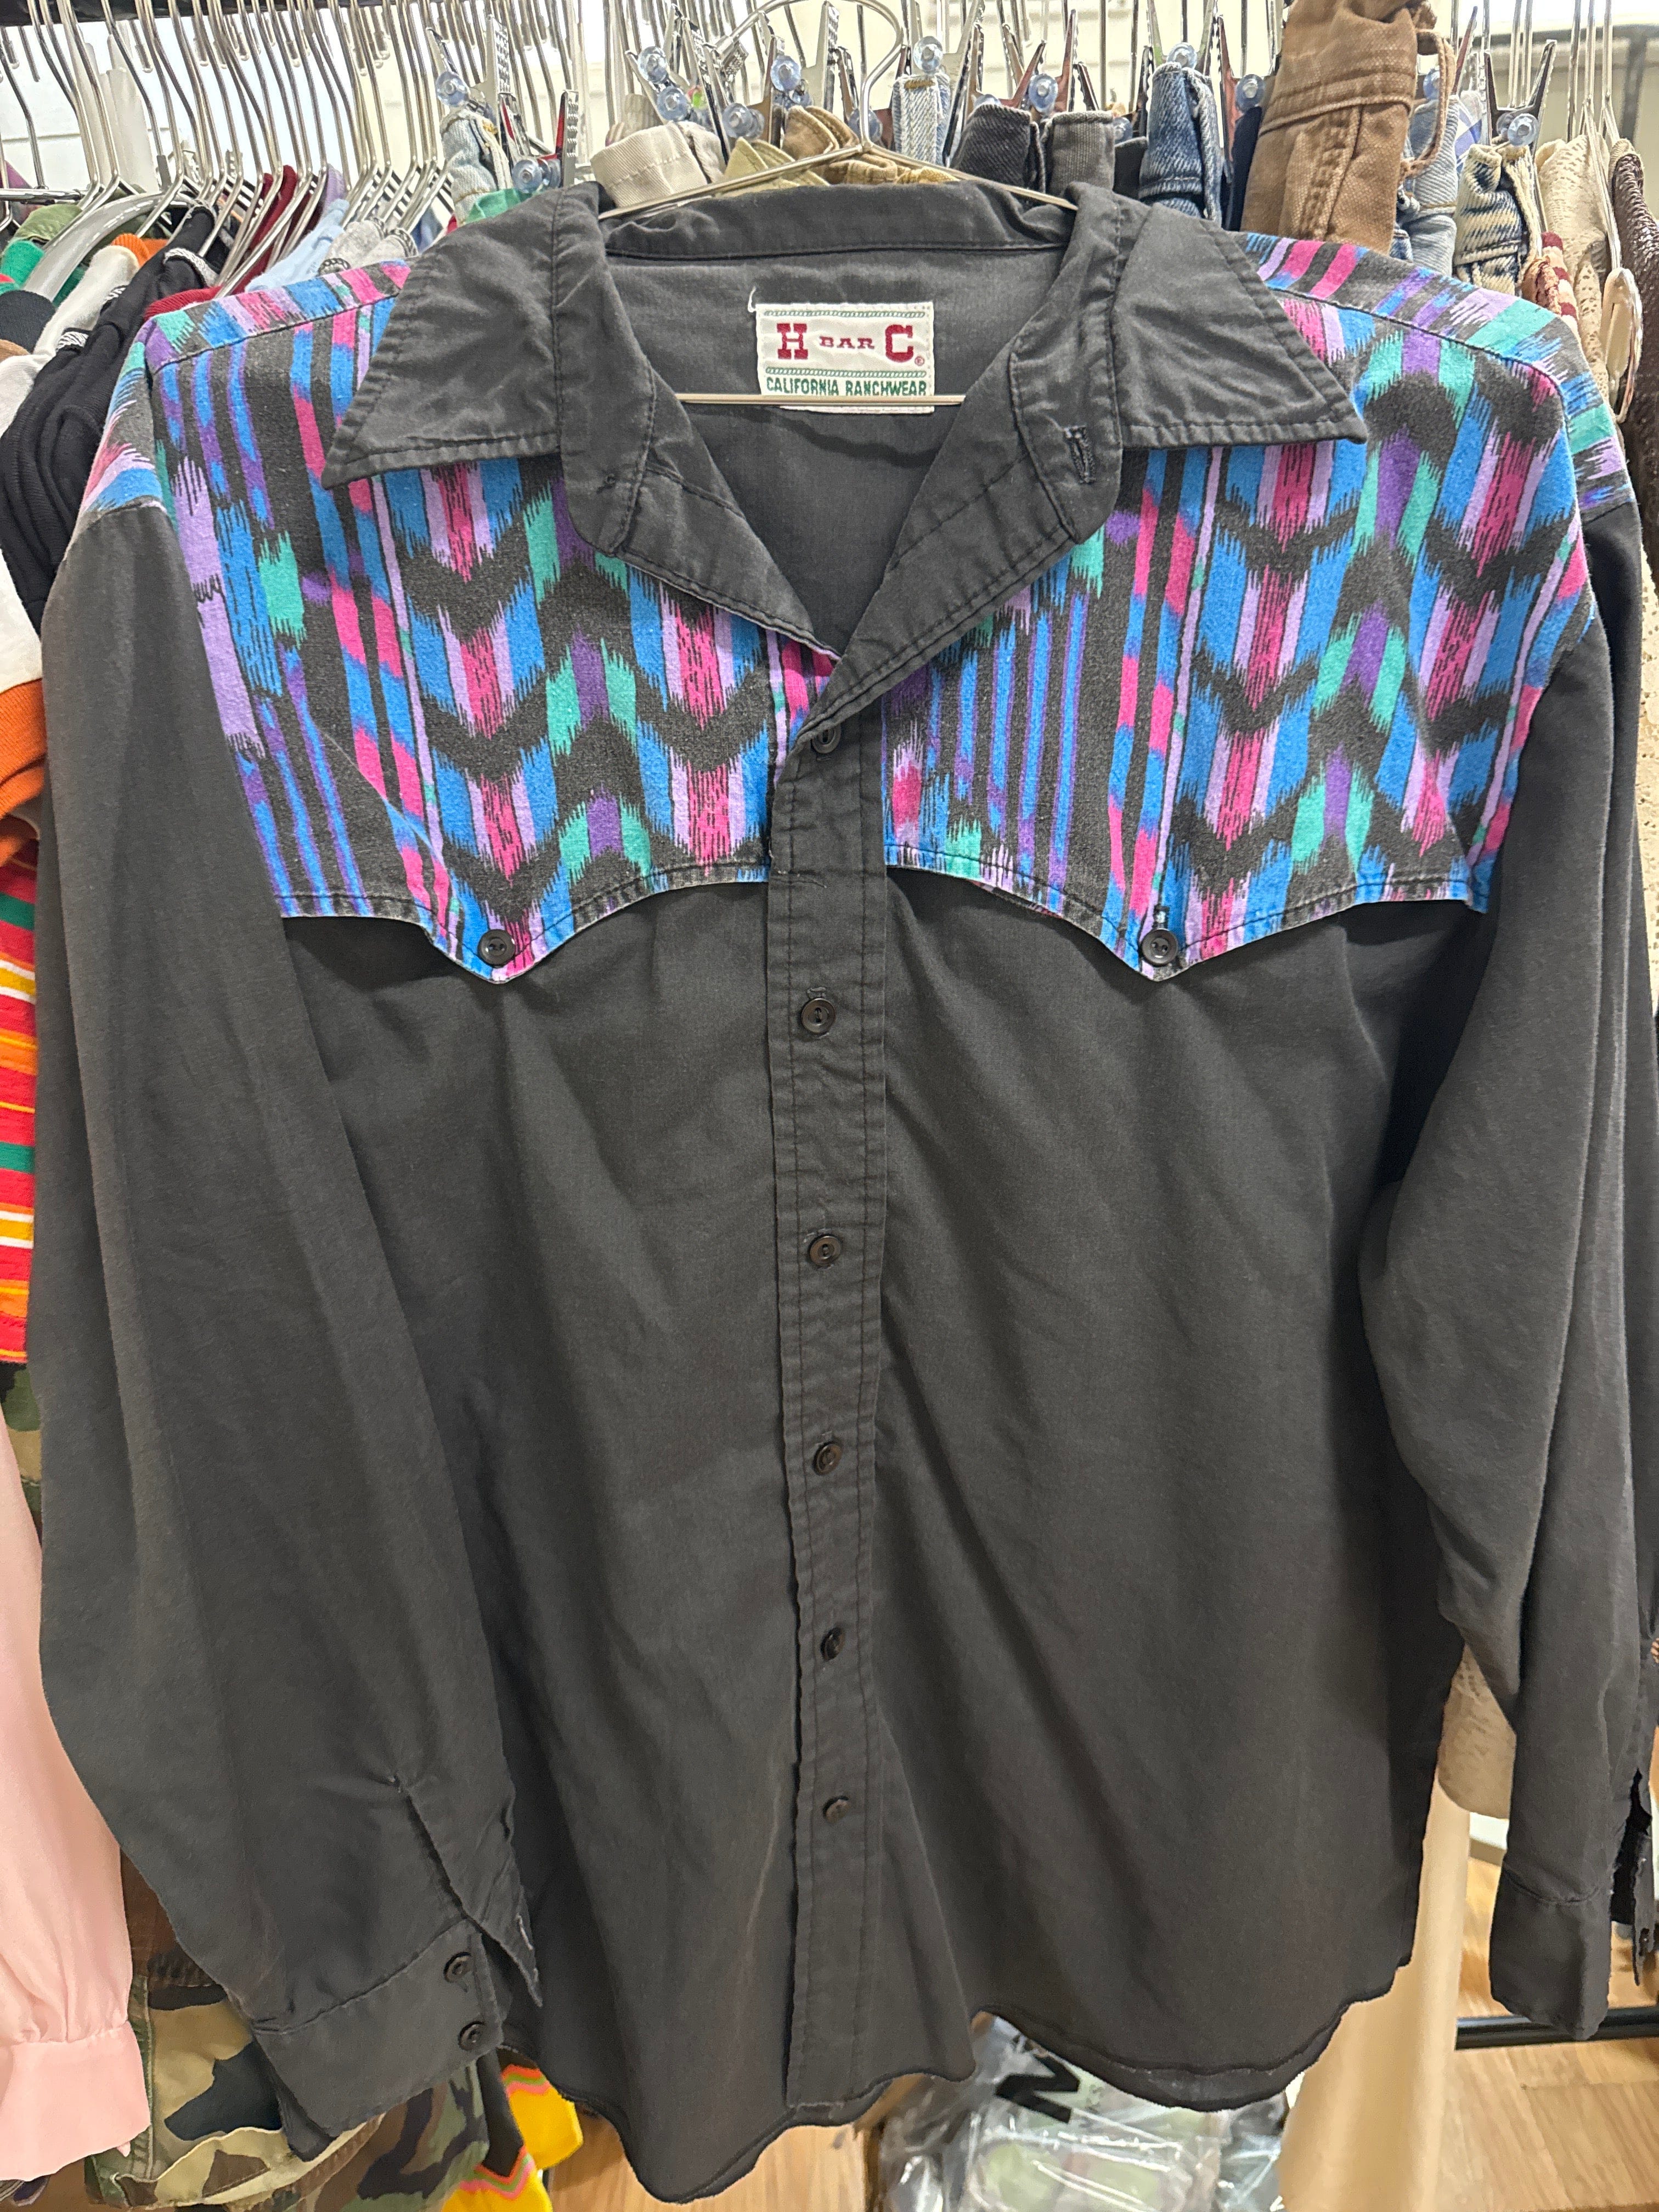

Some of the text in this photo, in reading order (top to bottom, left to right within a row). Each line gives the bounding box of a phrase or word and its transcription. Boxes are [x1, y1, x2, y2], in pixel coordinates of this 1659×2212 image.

[777, 323, 808, 360] H
[820, 336, 874, 349] BAR
[767, 377, 927, 396] CALIFORNIA RANCHWEAR
